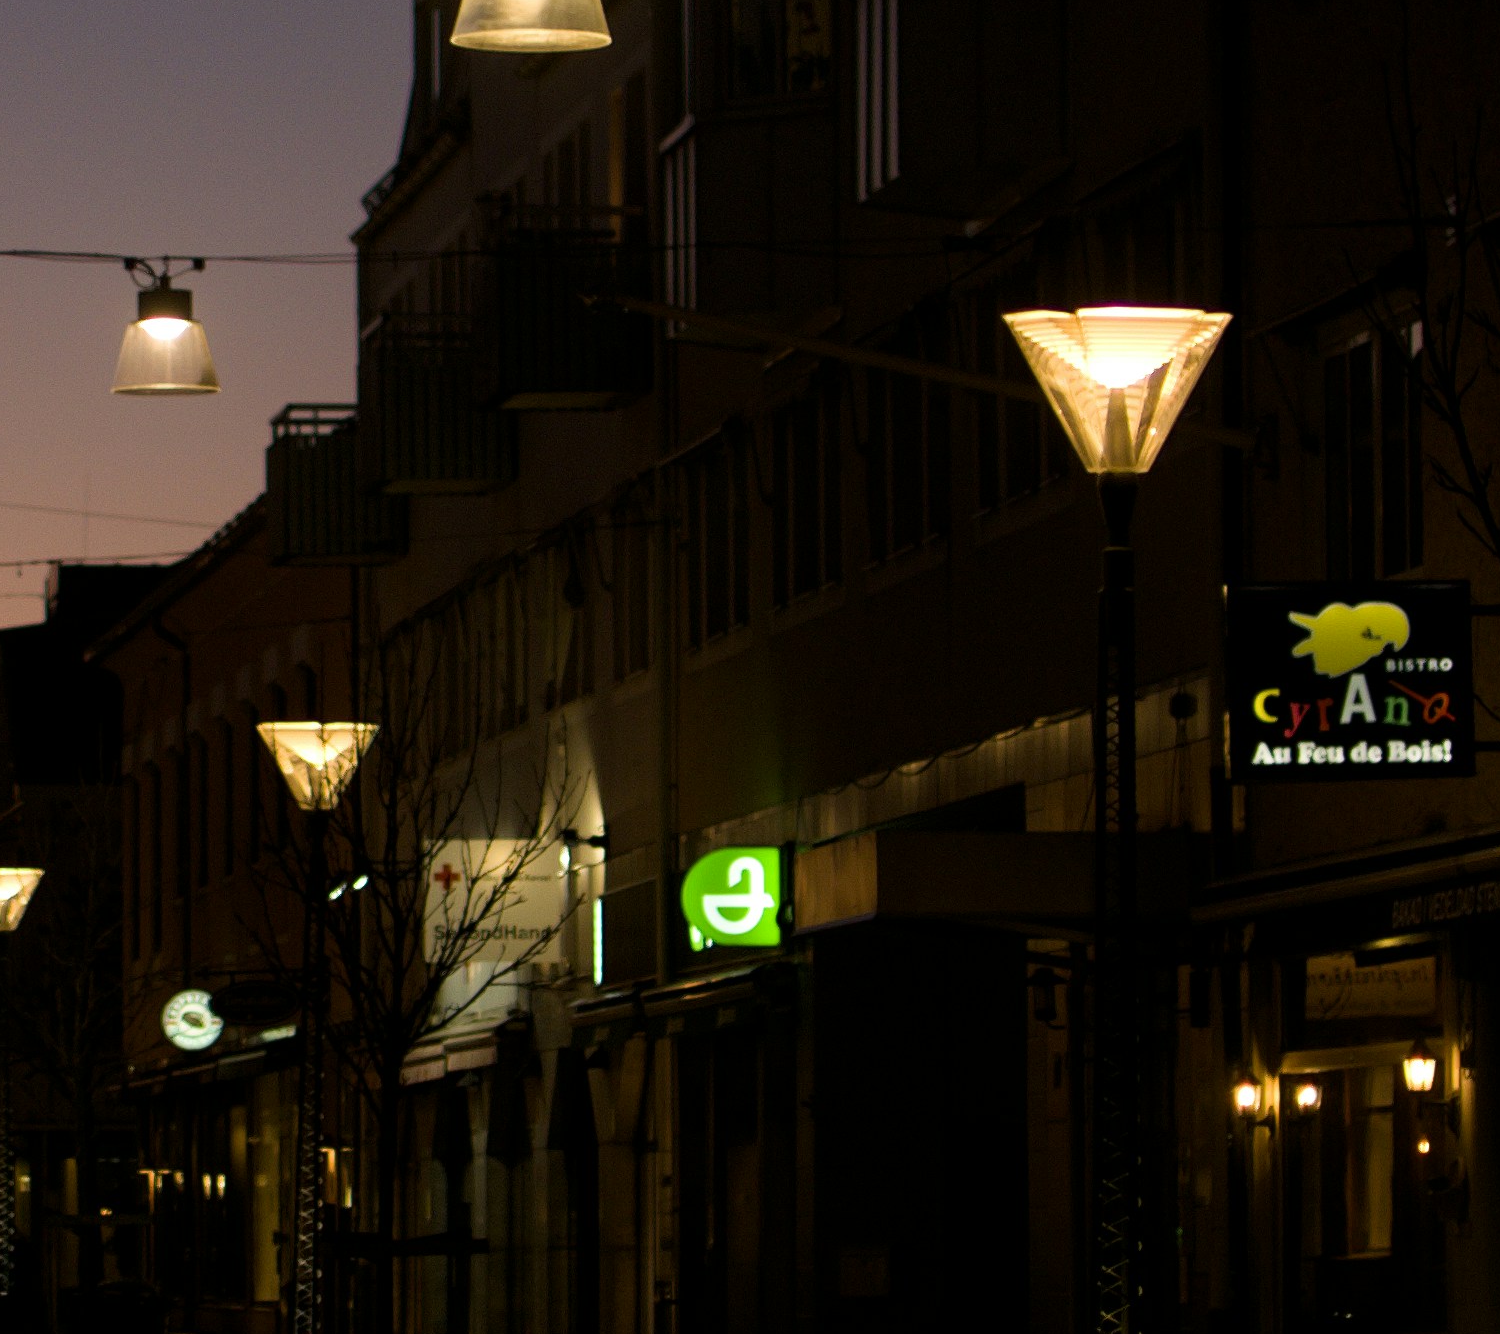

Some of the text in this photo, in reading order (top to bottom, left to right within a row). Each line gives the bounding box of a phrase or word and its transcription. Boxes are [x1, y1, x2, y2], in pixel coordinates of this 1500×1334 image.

[1385, 657, 1454, 673] BISTRO
[1252, 738, 1453, 766] Au Feu de Bois!
